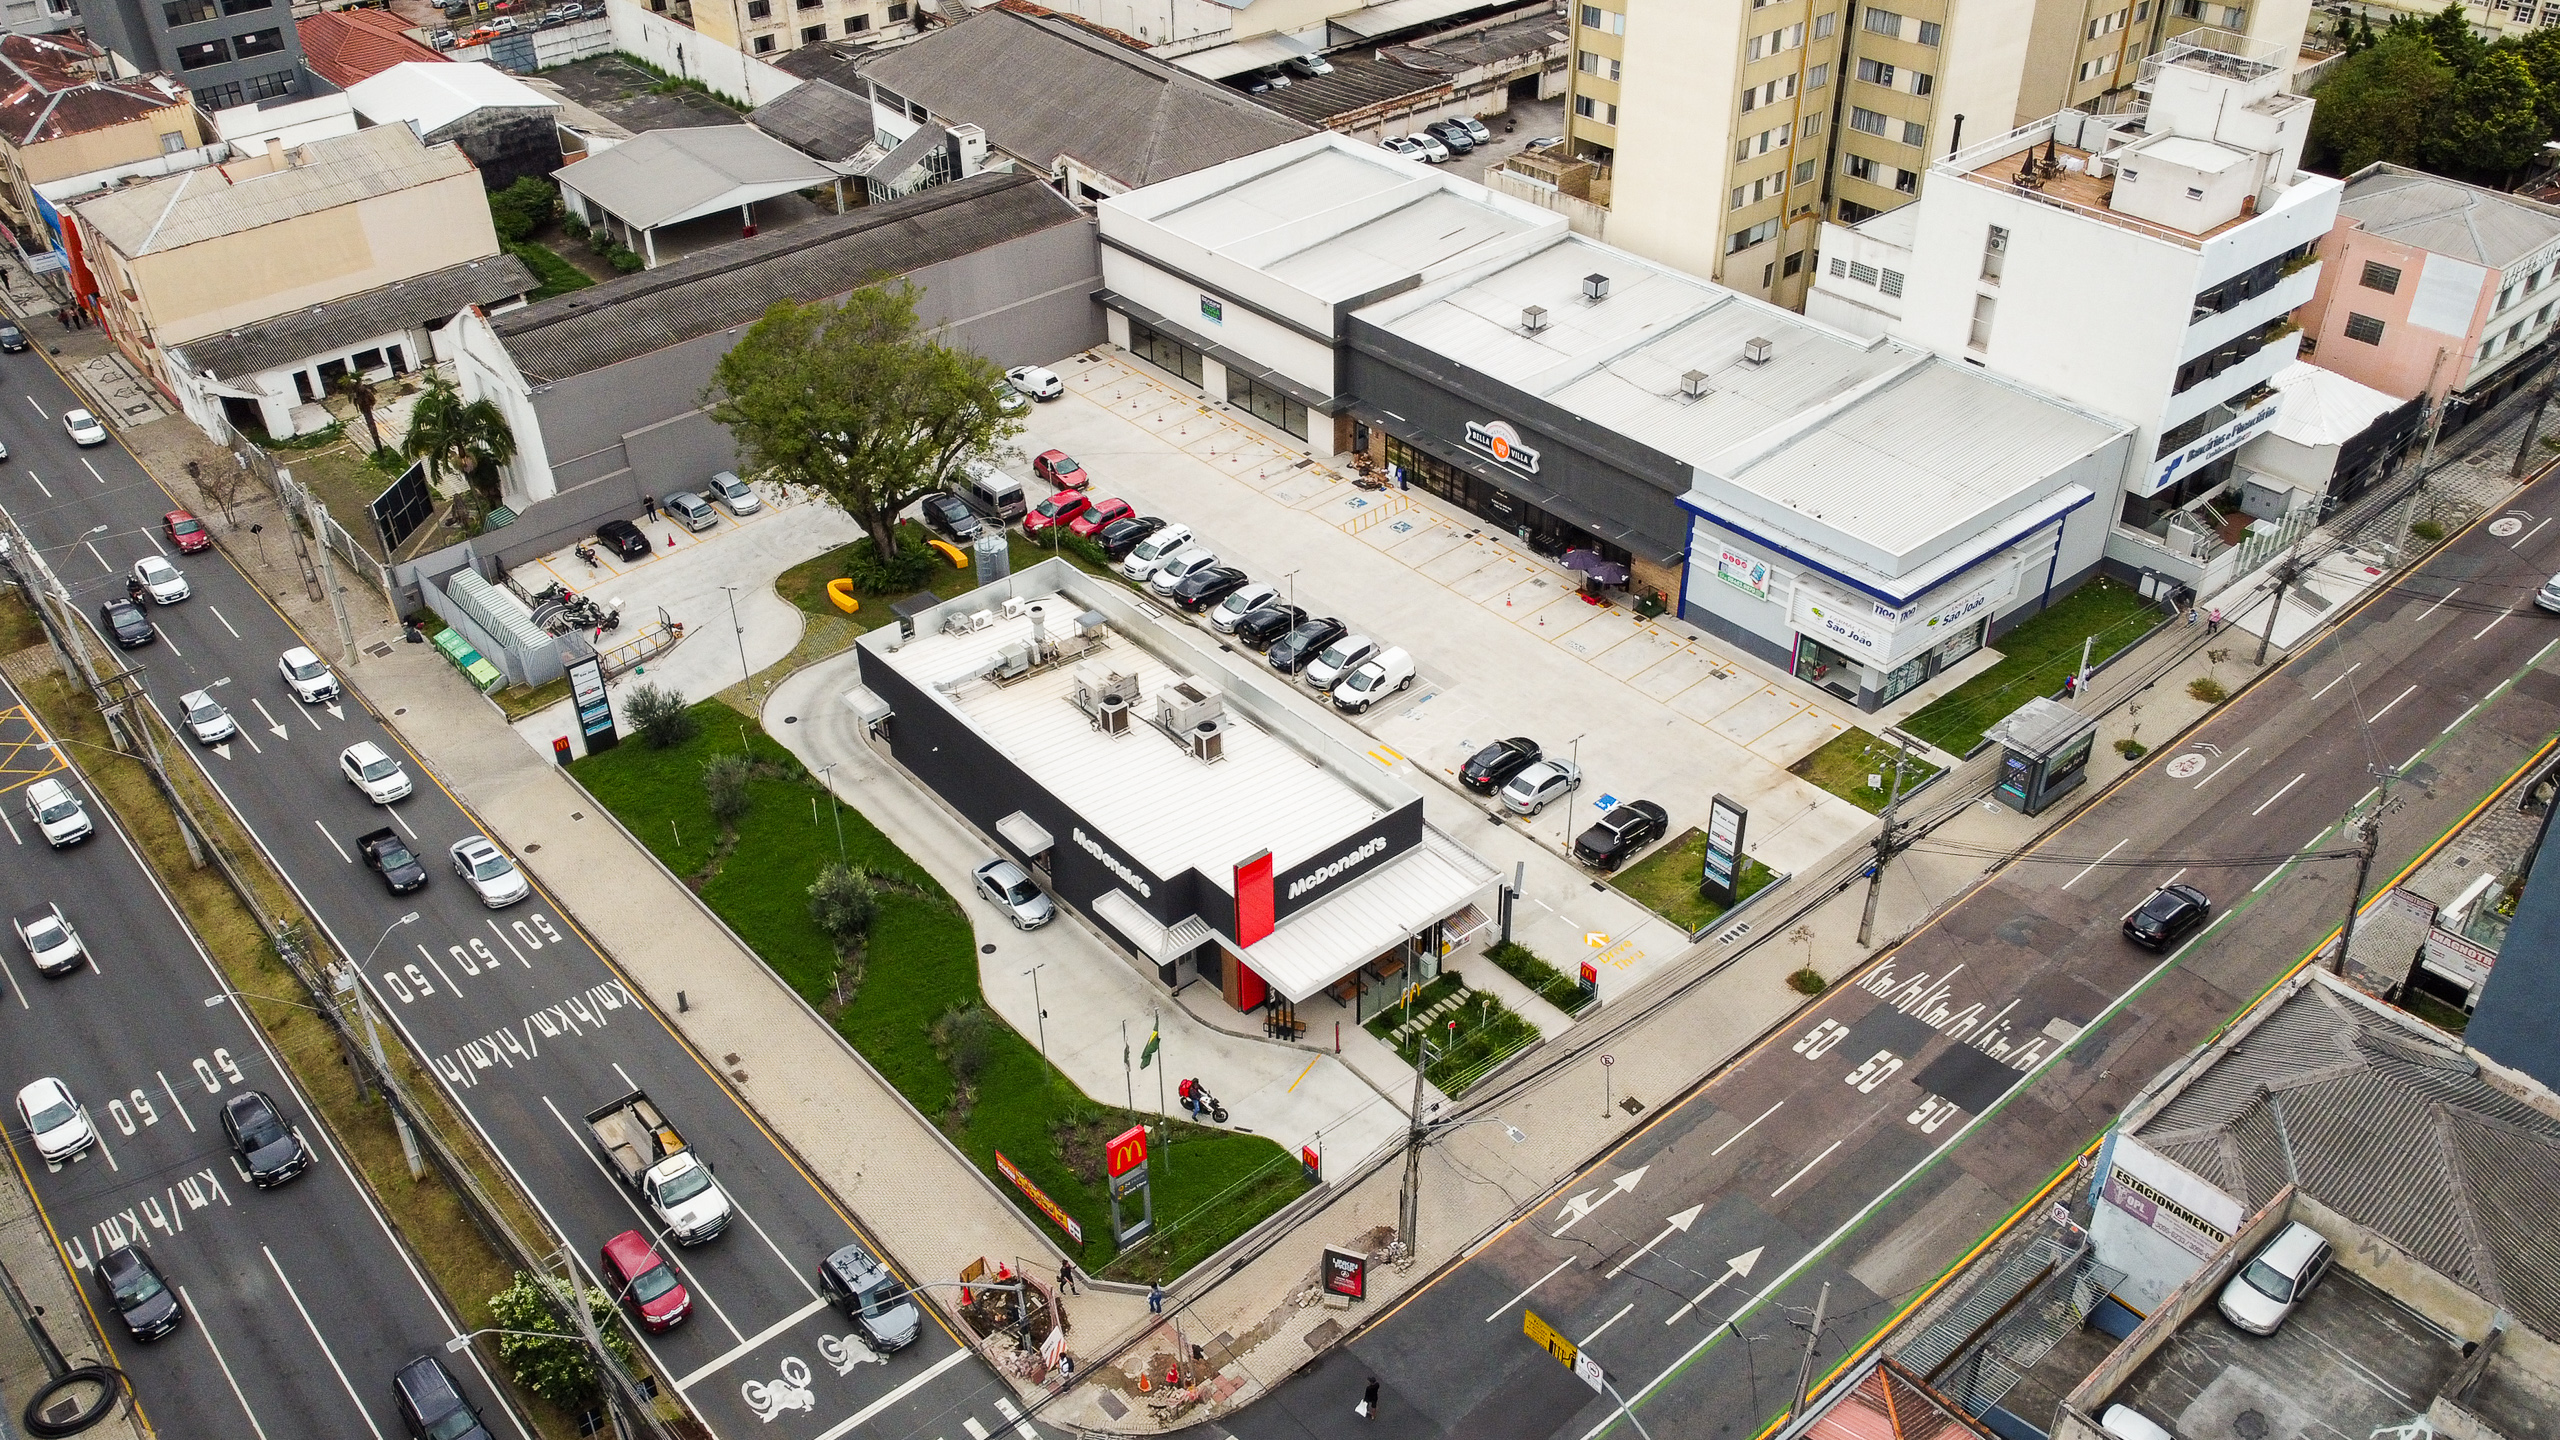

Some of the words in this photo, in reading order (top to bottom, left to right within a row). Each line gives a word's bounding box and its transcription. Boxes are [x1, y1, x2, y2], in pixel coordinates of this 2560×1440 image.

[1472, 431, 1490, 446] BELLA
[1511, 449, 1528, 464] VILLA
[1826, 620, 1846, 634] São
[1847, 631, 1872, 647] João
[1073, 827, 1151, 899] McDonald's
[1287, 835, 1387, 900] McDonald's
[511, 913, 562, 950] 50
[449, 938, 500, 976] 50
[1598, 940, 1633, 964] Drive
[1612, 950, 1645, 970] Thru
[384, 964, 435, 1004] 50
[1792, 1018, 1850, 1061] 50
[192, 1048, 244, 1094] 50
[1844, 1049, 1904, 1094] 50
[108, 1089, 159, 1136] 50
[1906, 1094, 1961, 1134] 50
[2115, 1169, 2225, 1243] ESTACIONAMENTO
[2127, 1195, 2145, 1213] OPL
